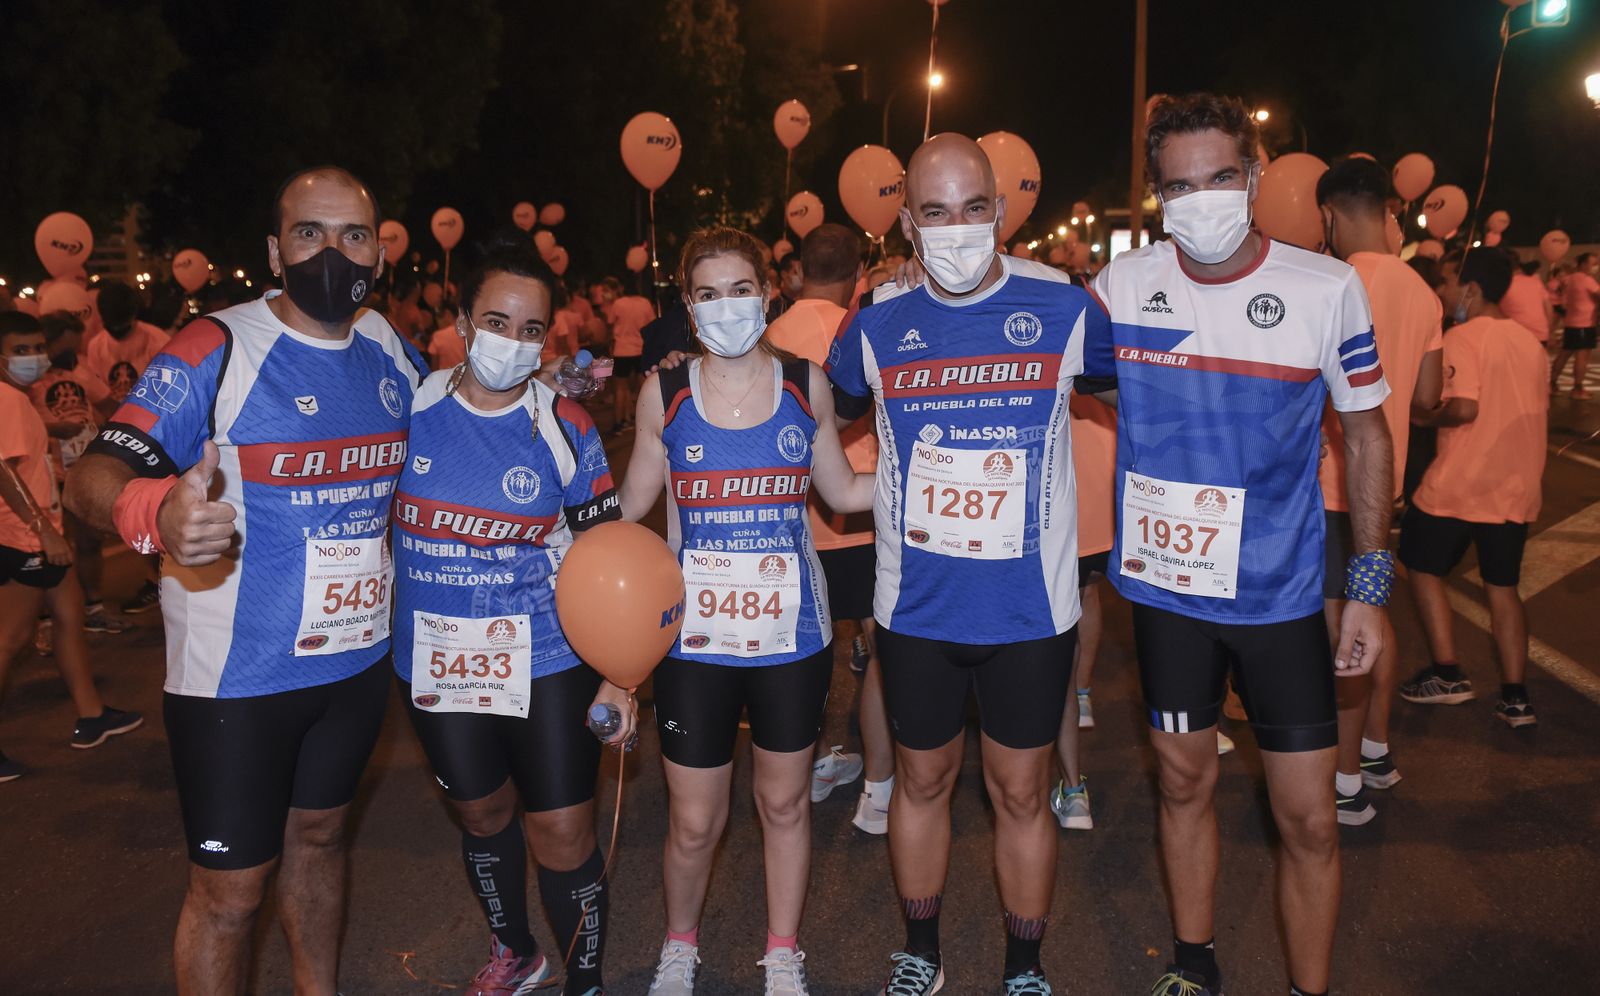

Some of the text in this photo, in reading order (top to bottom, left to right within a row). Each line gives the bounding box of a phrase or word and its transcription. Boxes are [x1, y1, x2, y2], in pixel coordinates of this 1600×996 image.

[879, 181, 903, 197] KH7
[1019, 179, 1039, 192] KH
[893, 362, 1043, 390] C.A. PUEBLA
[904, 396, 1033, 412] LA PUEBLA DEL RIO
[270, 451, 332, 477] C.A.
[677, 475, 810, 500] C.A. PUEBLA
[291, 490, 313, 505] LA
[922, 484, 1008, 520] 1287
[578, 505, 601, 522] C.A.
[689, 511, 702, 525] LA
[704, 509, 755, 524] PUEBLA
[758, 508, 780, 523] DEL
[302, 523, 339, 541] LAS
[431, 509, 545, 543] PUEBLA
[732, 529, 760, 538] CUÑAS
[1137, 515, 1220, 556] 1937
[402, 534, 413, 550] LA
[414, 538, 467, 558] PUEBLA
[470, 547, 495, 561] DEL
[696, 536, 794, 551] LAS MELONAS
[1137, 547, 1159, 560] ISRAEL
[1160, 554, 1186, 568] GAVIRA
[1187, 559, 1215, 571] LÓPEZ
[408, 566, 433, 584] LAS
[435, 571, 515, 587] MELONAS
[441, 564, 473, 574] CUÑAS
[322, 573, 387, 615] 5436
[697, 589, 783, 620] 9484
[310, 619, 344, 629] LUCIANO
[345, 614, 368, 626] BOADO
[429, 650, 512, 679] 5433
[458, 680, 487, 690] GARCÍA
[488, 682, 505, 690] RUIZ
